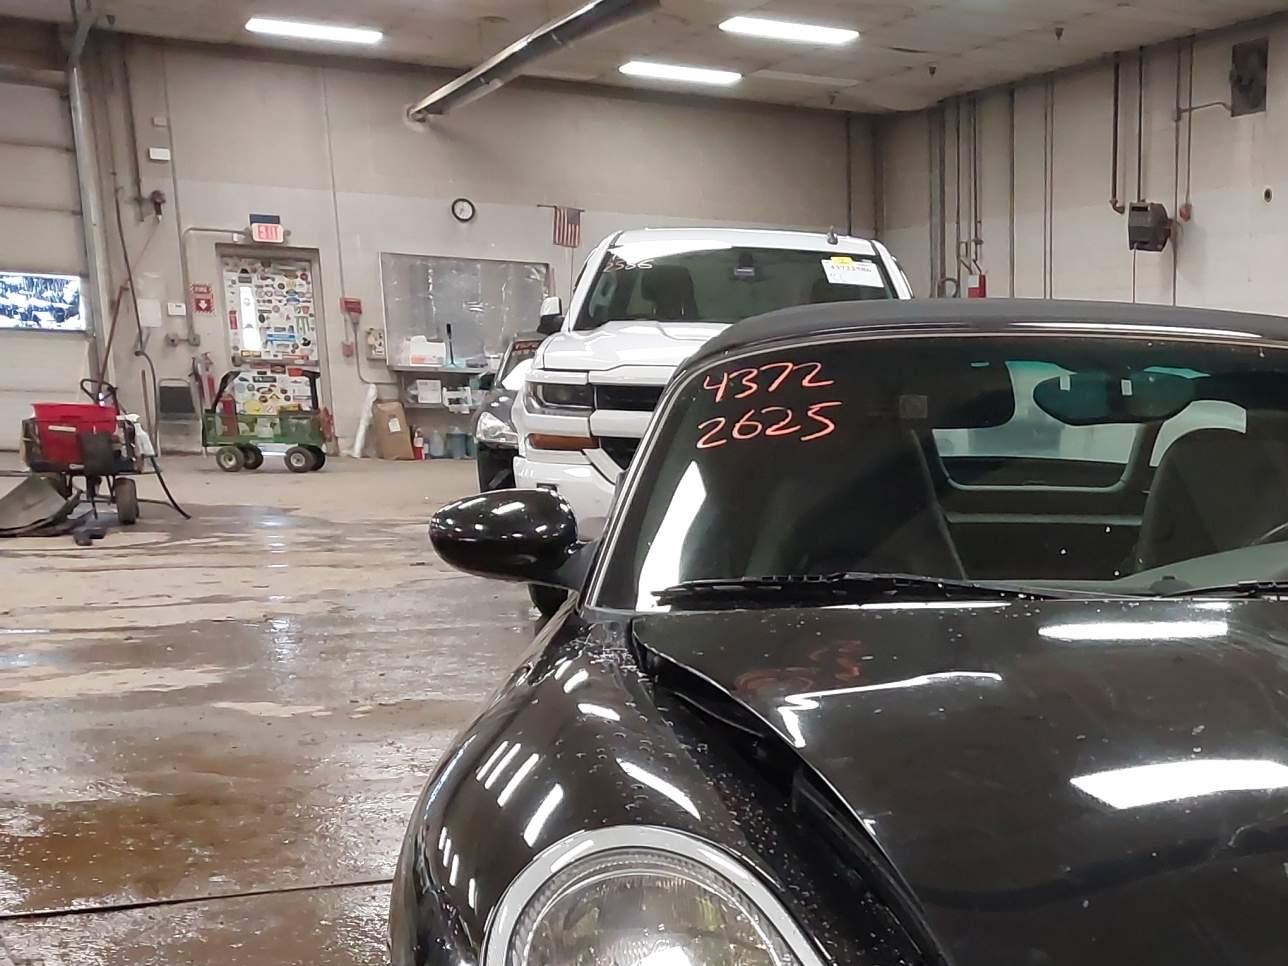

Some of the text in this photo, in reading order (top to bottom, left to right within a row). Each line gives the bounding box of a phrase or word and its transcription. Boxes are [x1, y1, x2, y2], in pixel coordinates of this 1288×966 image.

[257, 225, 279, 240] EXIT
[703, 362, 835, 403] 4372
[696, 401, 843, 449] 2625
